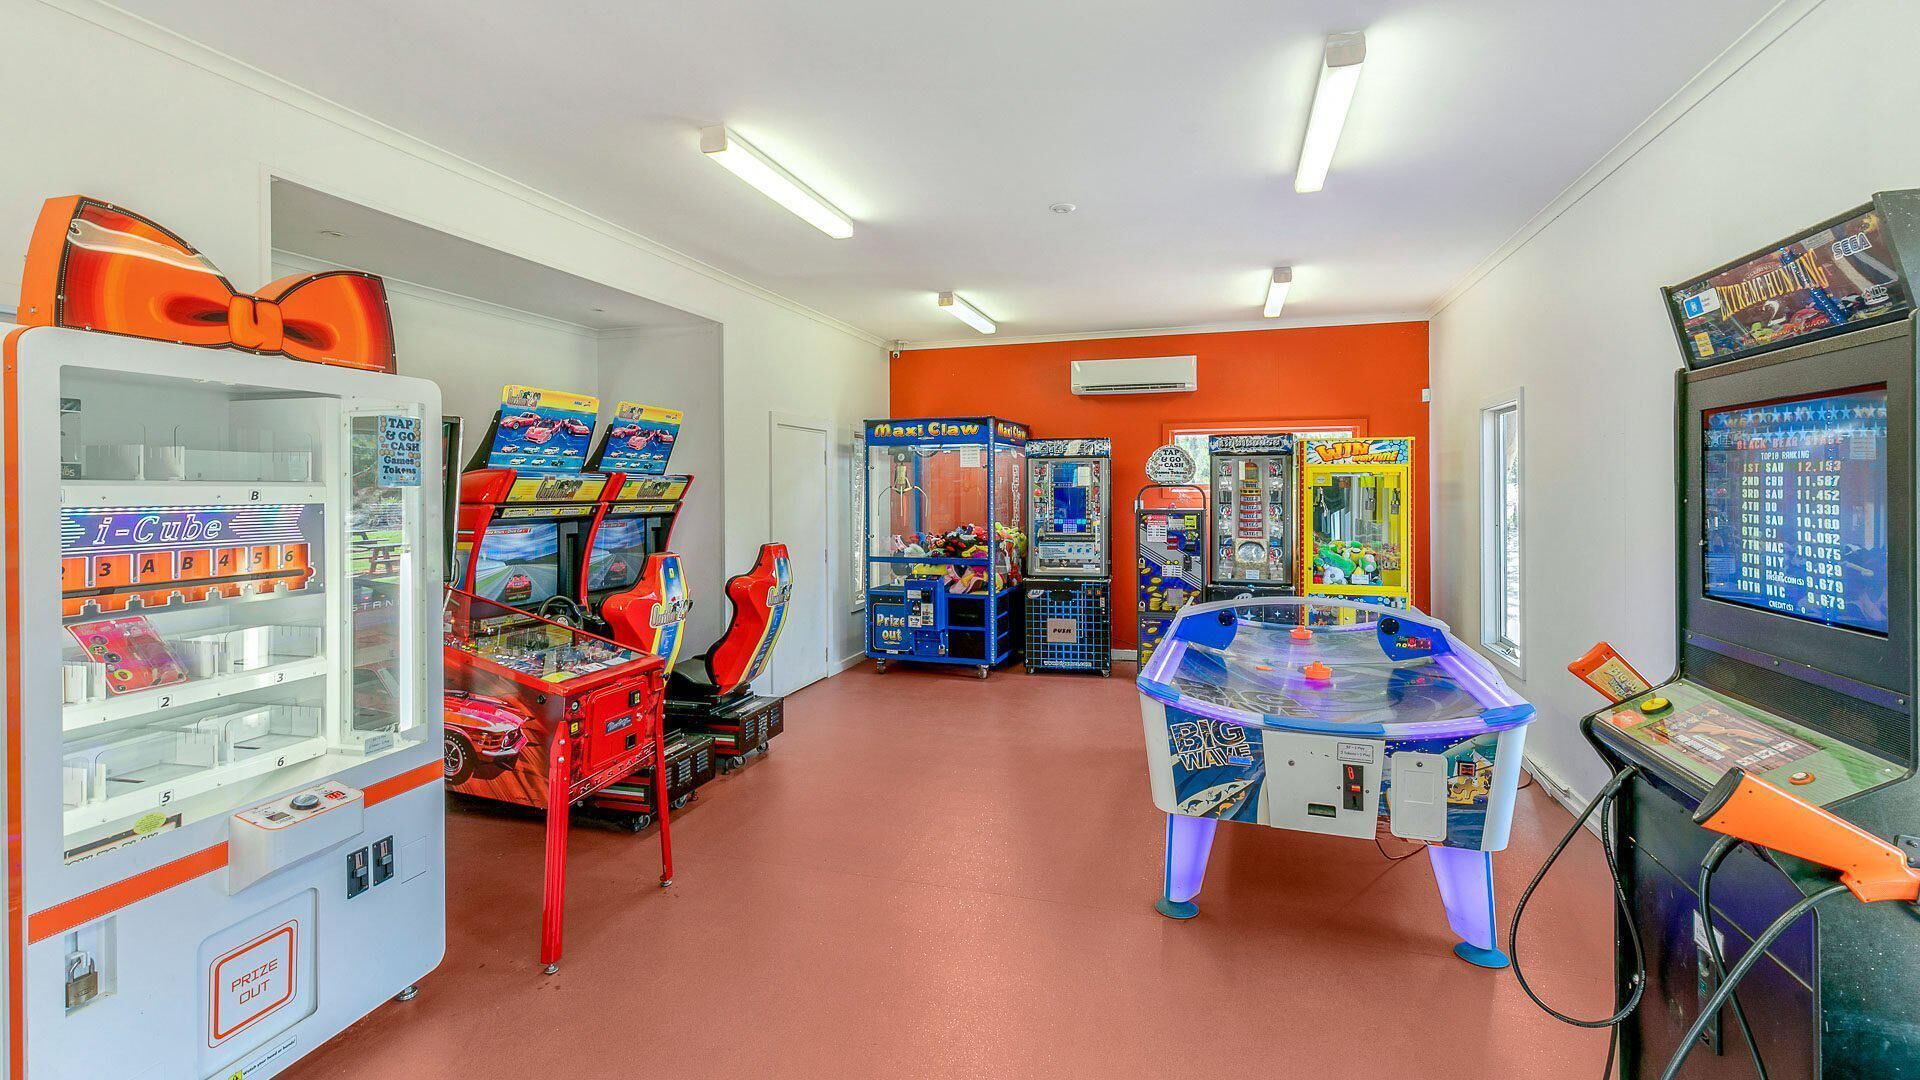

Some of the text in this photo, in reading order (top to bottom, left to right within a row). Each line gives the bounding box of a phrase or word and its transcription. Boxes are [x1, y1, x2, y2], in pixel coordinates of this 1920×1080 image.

[1832, 232, 1872, 260] SEGA
[1716, 276, 1767, 321] EXTREME
[1763, 248, 1829, 300] HUNTING
[1763, 300, 1787, 327] 2
[388, 417, 413, 429] TAP
[385, 430, 415, 441] & GO
[874, 422, 980, 438] Maxi Claw
[997, 423, 1027, 440] Maxi Claw
[391, 442, 419, 451] CASH
[1737, 440, 1767, 450] BLACK
[1772, 437, 1798, 448] BEAR
[1314, 441, 1370, 462] WIN
[1782, 450, 1810, 460] RANKING
[384, 455, 414, 464] Games
[383, 465, 416, 474] Tokens
[1743, 463, 1759, 473] 1ST
[251, 491, 259, 500] B
[1742, 489, 1759, 499] 3RD
[1742, 502, 1759, 511] 4TH
[1742, 514, 1759, 524] 5TH
[92, 513, 222, 546] i-Cube
[1742, 539, 1759, 550] 7TH
[99, 550, 294, 577] 3 A B 4 5 6
[876, 614, 904, 627] Prize
[882, 629, 902, 641] out
[277, 673, 284, 682] 3
[160, 697, 170, 708] 2
[1170, 719, 1246, 753] BIG
[277, 756, 284, 767] 6
[1179, 743, 1254, 771] WAVE
[161, 791, 171, 803] 5
[231, 958, 278, 993] PRIZE
[239, 979, 270, 1005] OUT
